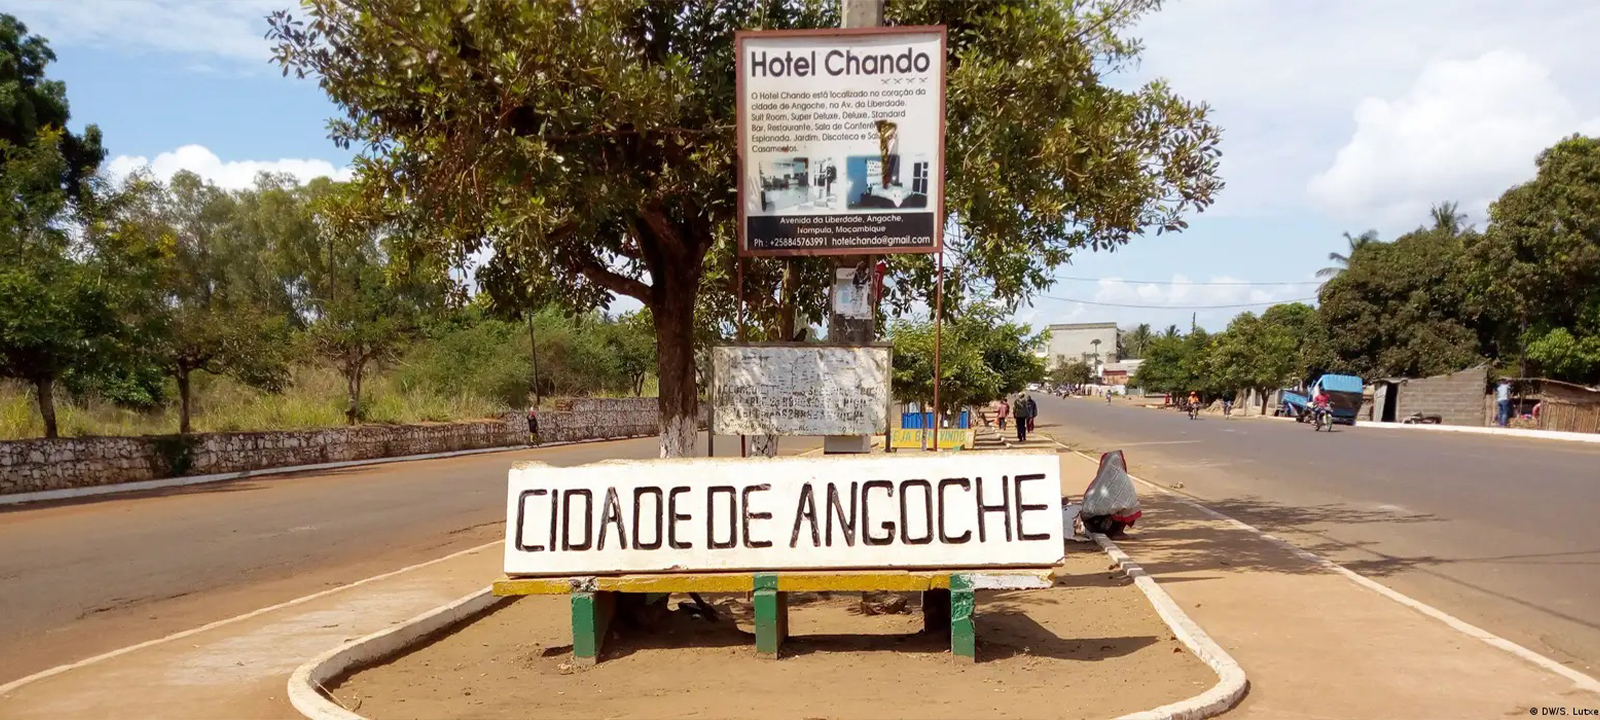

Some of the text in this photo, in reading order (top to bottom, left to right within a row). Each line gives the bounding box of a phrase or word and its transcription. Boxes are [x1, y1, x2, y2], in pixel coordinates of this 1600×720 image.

[751, 47, 930, 77] Hotel Chando
[751, 92, 758, 100] O
[760, 91, 779, 100] Hotel
[780, 91, 811, 100] Chando
[812, 90, 828, 99] está
[829, 90, 868, 98] localizado
[881, 88, 913, 98] coração
[915, 88, 926, 96] da
[751, 102, 778, 111] cidade
[779, 102, 790, 110] de
[791, 102, 828, 111] Angoche,
[841, 101, 853, 109] Av.
[855, 100, 865, 108] da
[867, 99, 907, 108] Liberdade.
[791, 112, 812, 121] Super
[813, 111, 840, 121] Deluxe,
[842, 111, 870, 119] Deluxe,
[871, 109, 906, 119] Standard
[751, 124, 766, 133] Bar,
[767, 123, 813, 132] Restaurante,
[815, 123, 831, 131] Sala
[832, 122, 842, 130] de
[793, 133, 820, 142] Jardim,
[822, 132, 859, 141] Discoteca
[780, 214, 904, 225] Avenida da Liberdade, Angoche,
[797, 225, 886, 235] Nampula, Moçambique
[754, 238, 764, 247] Ph
[831, 234, 931, 247] hotelchando@gmail.com
[514, 473, 1051, 553] CIDADE DE ANGOCHE
